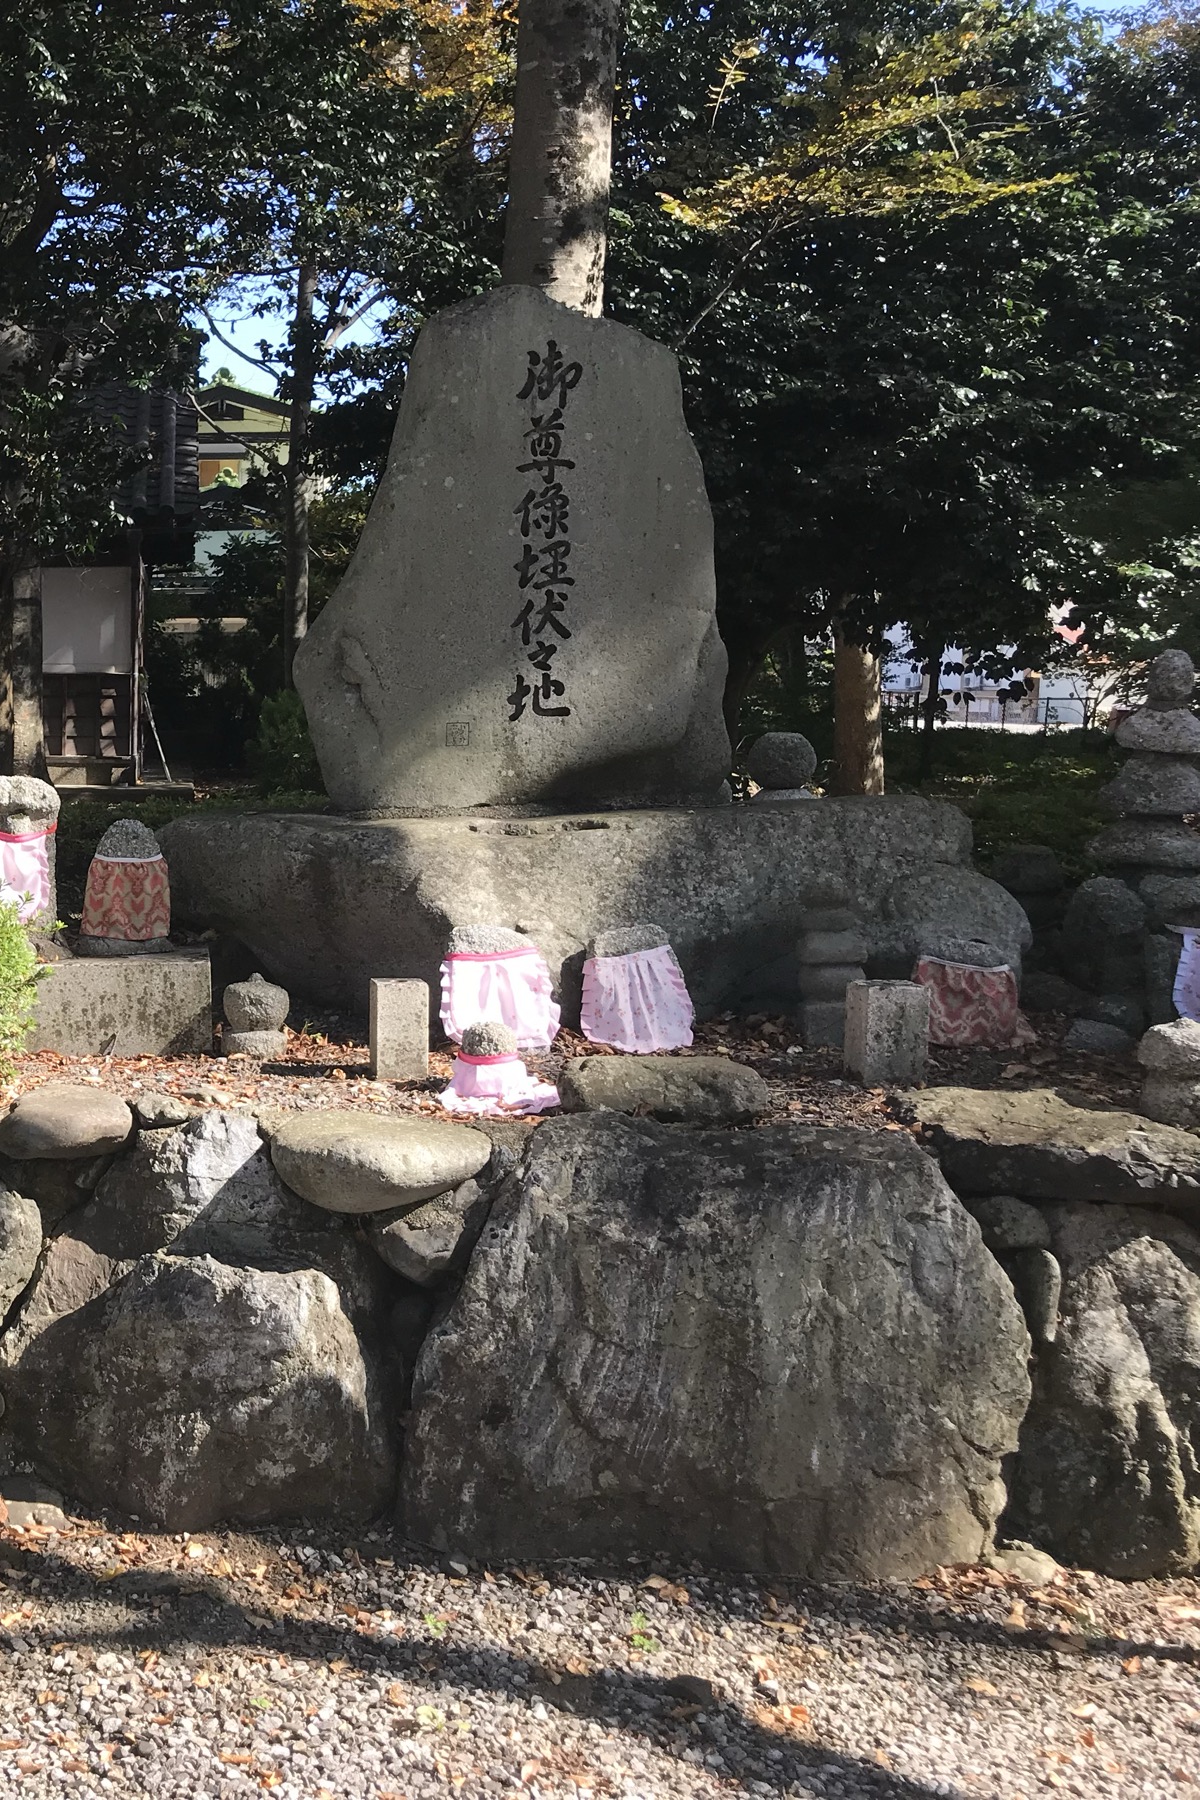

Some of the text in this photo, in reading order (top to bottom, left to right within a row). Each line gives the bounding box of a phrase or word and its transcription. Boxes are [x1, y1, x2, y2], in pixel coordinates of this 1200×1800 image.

[506, 339, 584, 722] 御尊像埋伏之地
